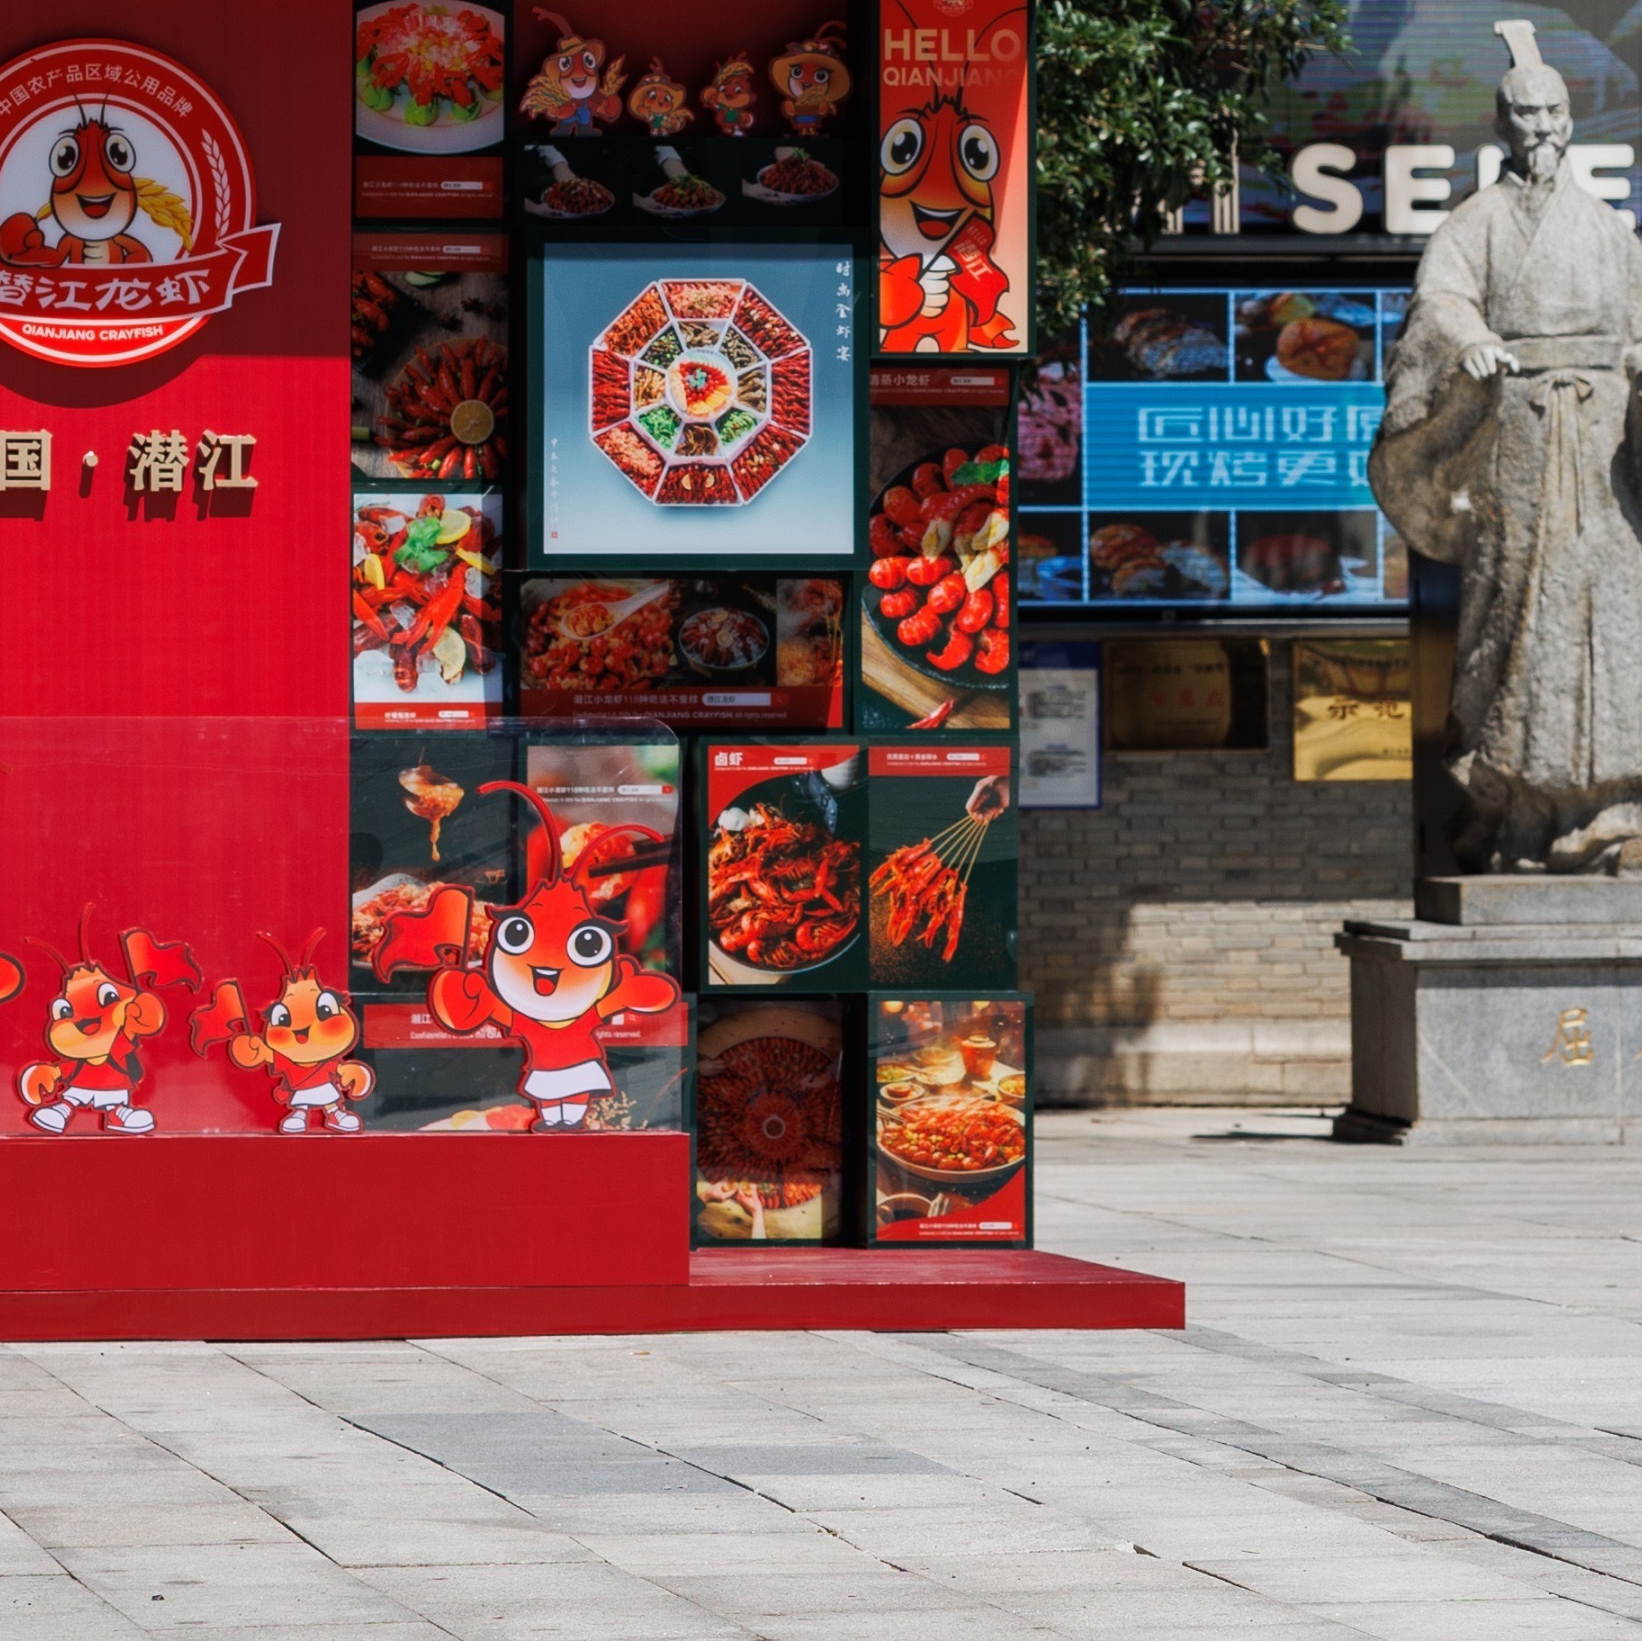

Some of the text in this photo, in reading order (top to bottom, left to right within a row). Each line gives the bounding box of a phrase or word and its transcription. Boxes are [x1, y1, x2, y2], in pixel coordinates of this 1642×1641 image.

[884, 28, 1021, 61] HELLO
[22, 323, 163, 341] QIANJIANG CRAYFISH
